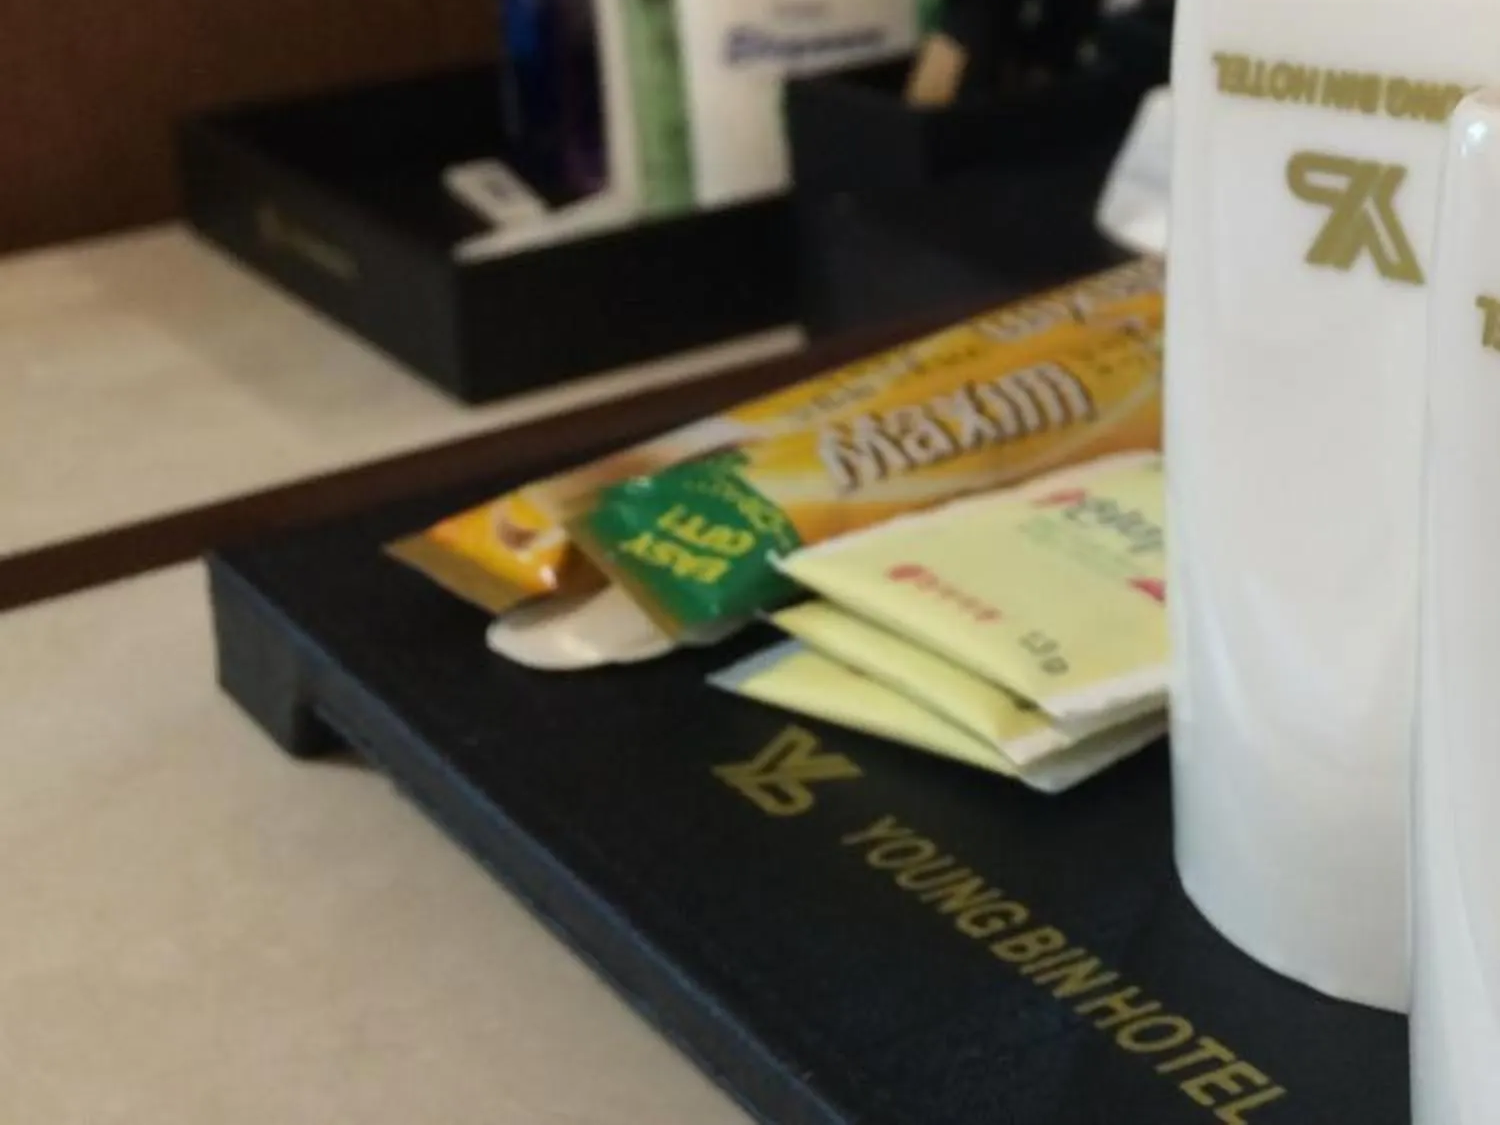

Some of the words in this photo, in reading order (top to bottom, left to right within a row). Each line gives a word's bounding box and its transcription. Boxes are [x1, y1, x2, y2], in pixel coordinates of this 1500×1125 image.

[1211, 52, 1320, 106] HOTEL
[1321, 68, 1384, 114] BIN
[818, 362, 1093, 496] Maxim
[620, 531, 732, 583] EASY
[842, 813, 1030, 939] YOUNG
[989, 926, 1121, 999] BIN
[1073, 985, 1288, 1125] HOTEL
